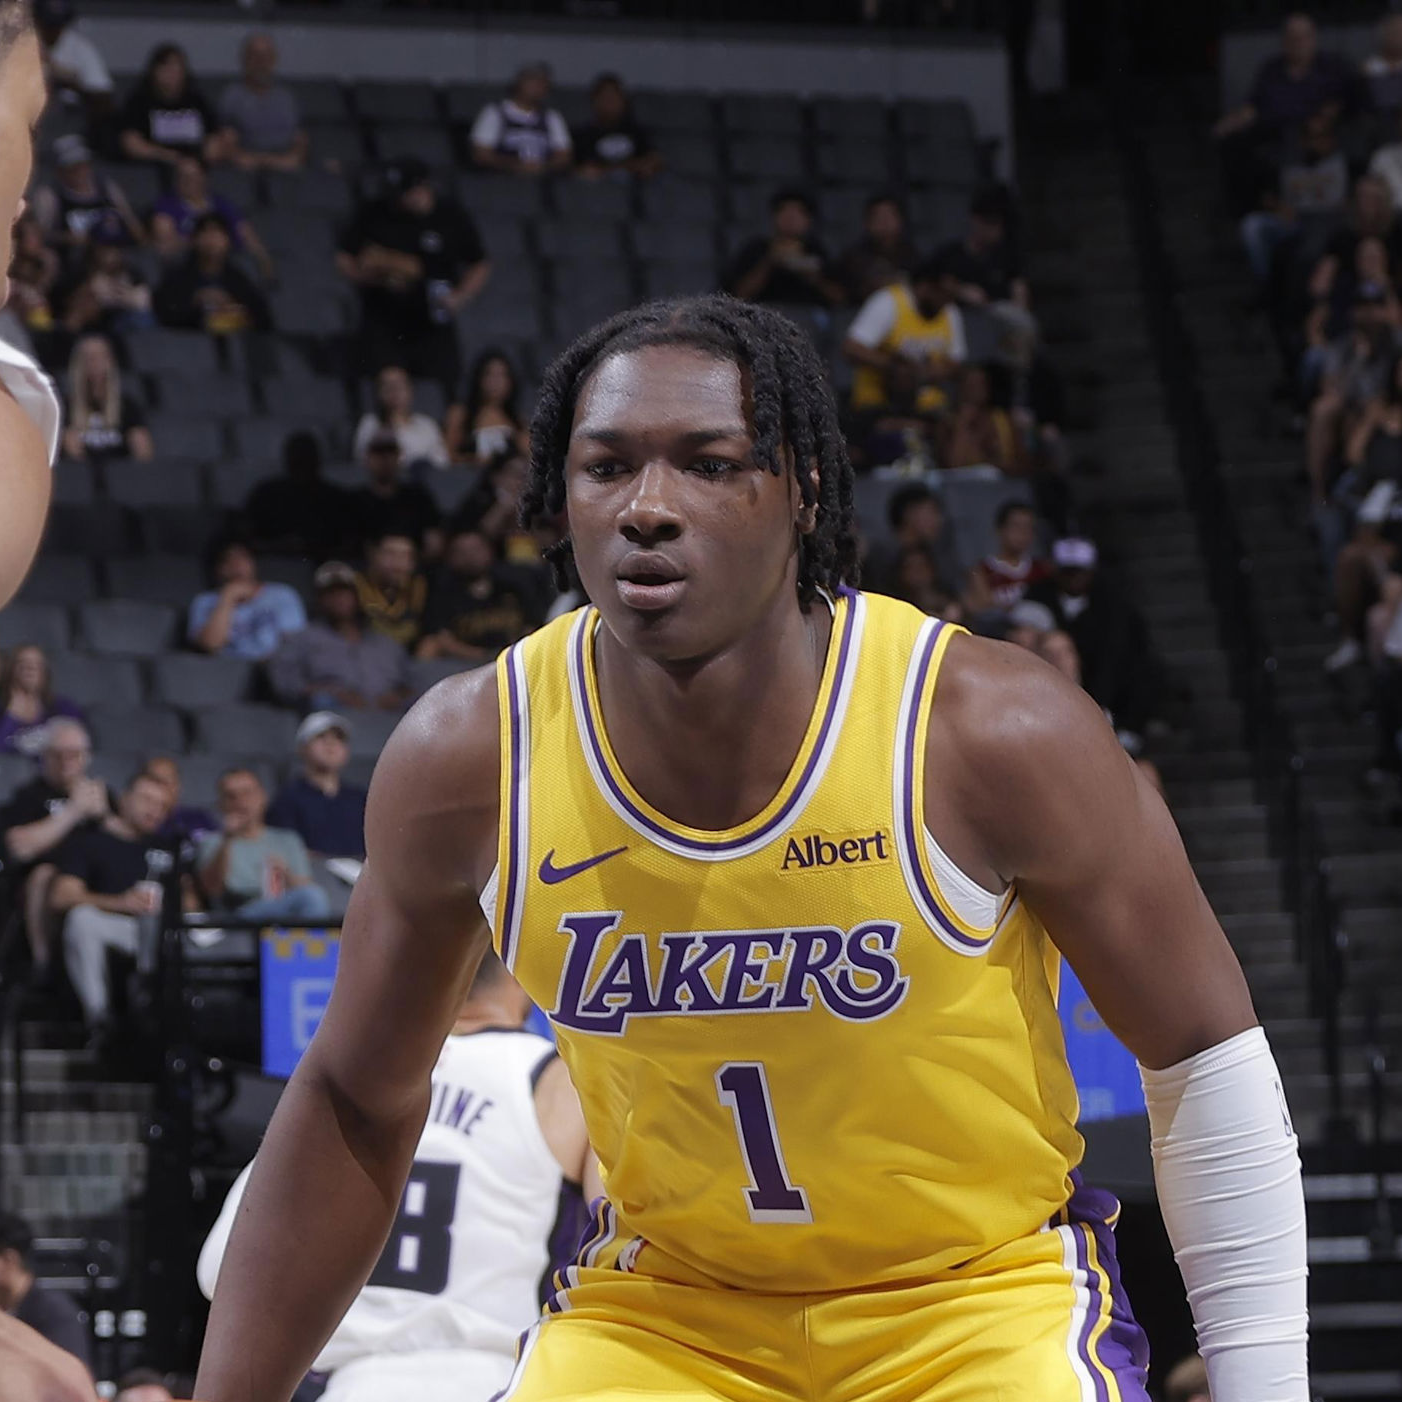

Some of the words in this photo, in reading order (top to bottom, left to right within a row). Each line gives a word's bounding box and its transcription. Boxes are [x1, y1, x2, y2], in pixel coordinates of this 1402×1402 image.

[780, 829, 890, 871] Albert
[545, 909, 911, 1038] LAKERS
[430, 1079, 496, 1137] INE
[713, 1060, 815, 1225] 1
[365, 1160, 463, 1297] 8
